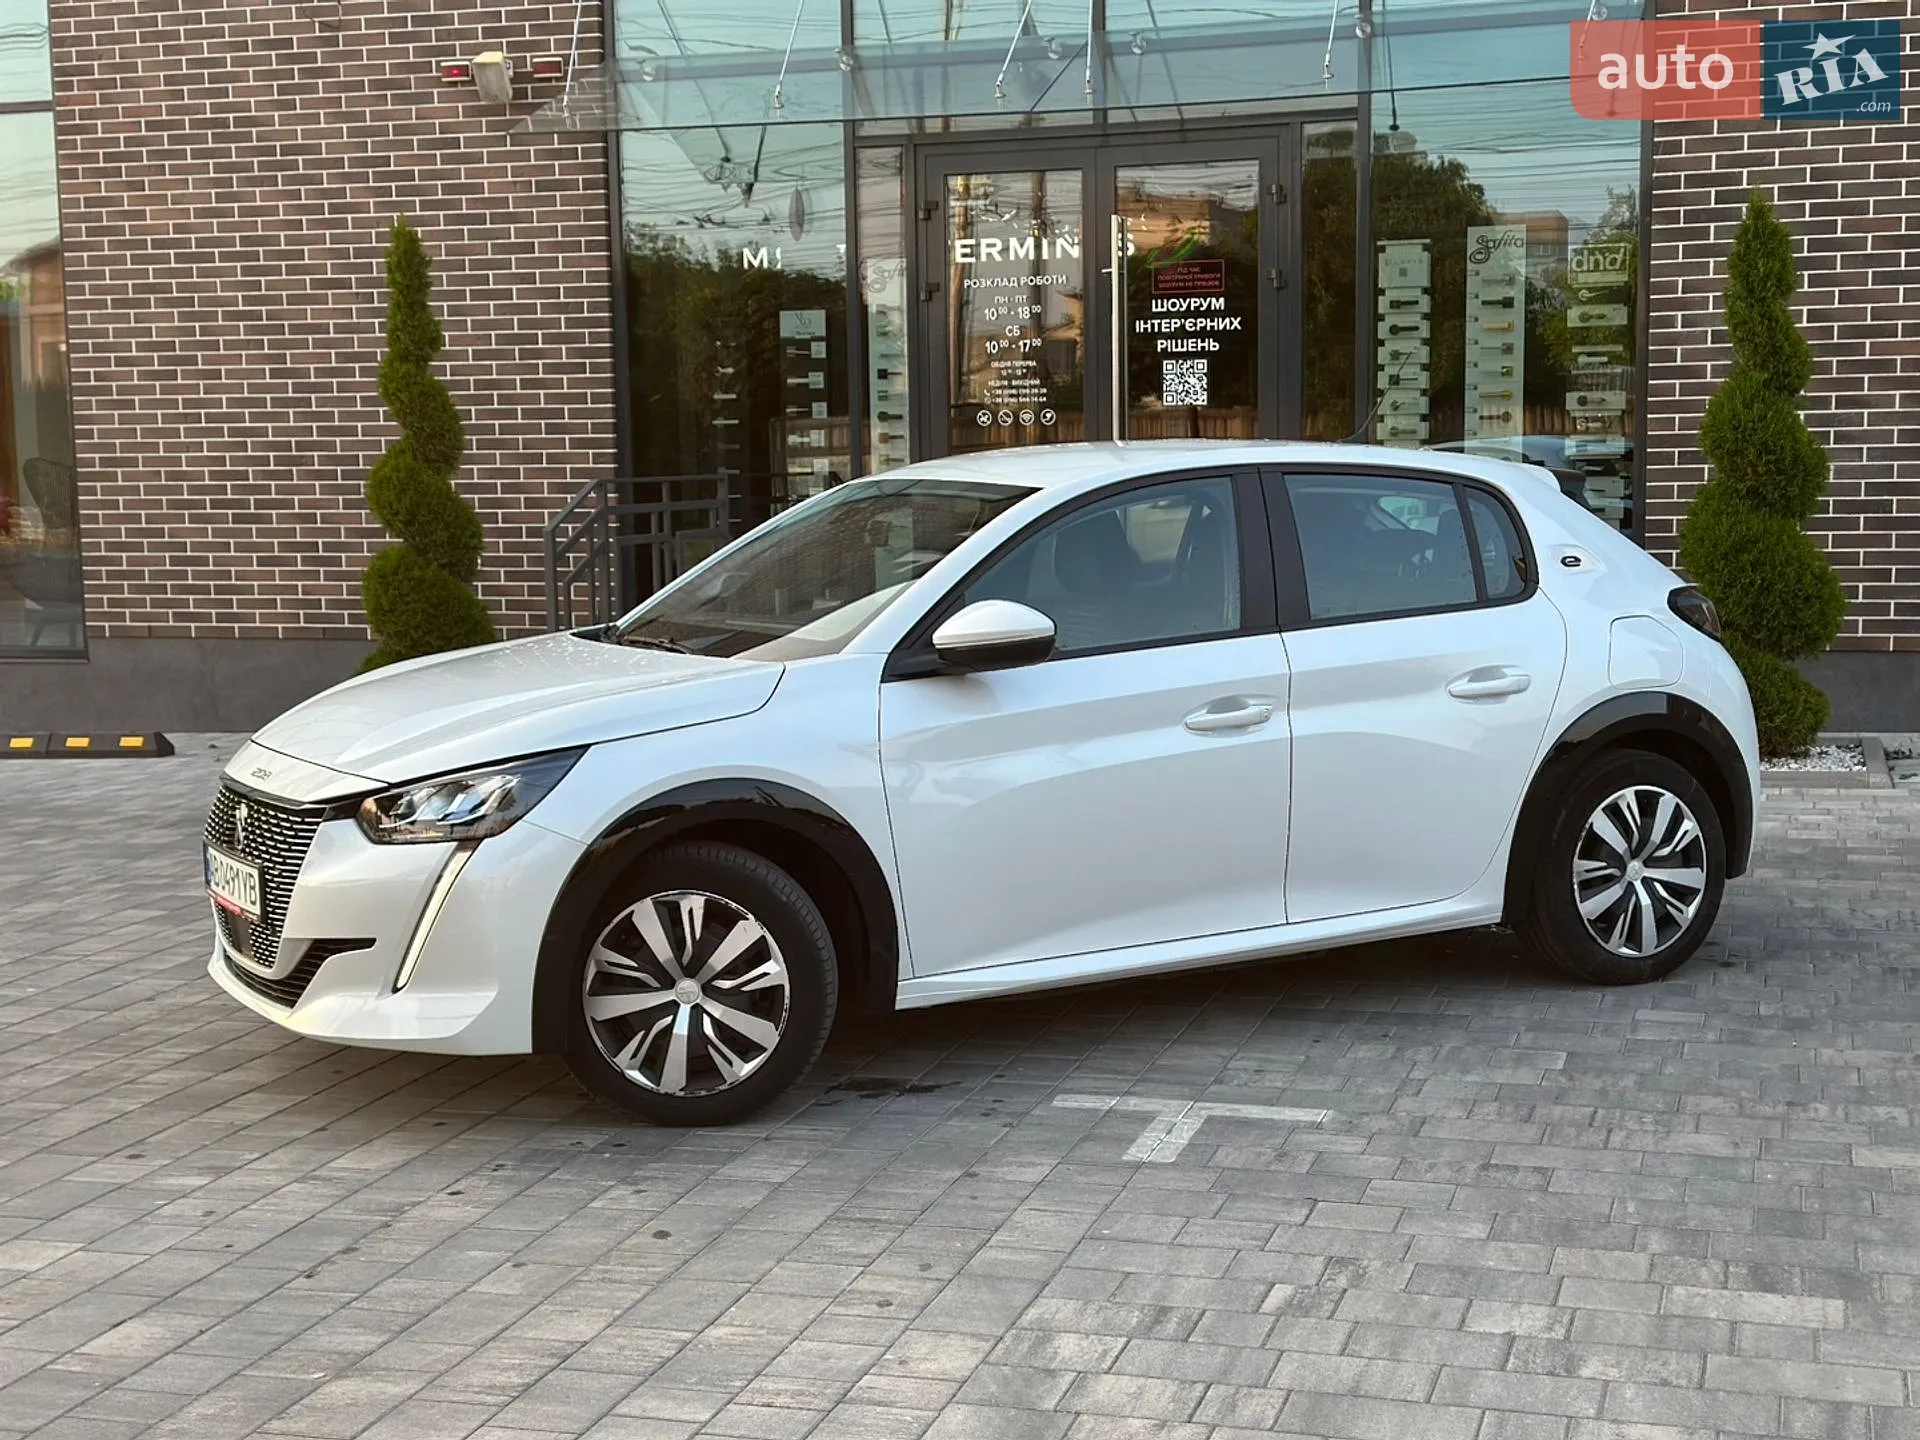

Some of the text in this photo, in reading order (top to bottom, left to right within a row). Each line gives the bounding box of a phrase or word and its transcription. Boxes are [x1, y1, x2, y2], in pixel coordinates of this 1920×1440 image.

[964, 275, 1067, 289] РОЗКЛАД РОБОТИ
[994, 295, 1009, 304] ПН
[1015, 294, 1028, 304] ПТ
[1151, 297, 1225, 312] ШОУРУМ
[1005, 325, 1021, 337] СБ
[1135, 316, 1242, 333] ІНТЕР'ЄРНИХ
[1156, 338, 1220, 352] РІШЕНЬ
